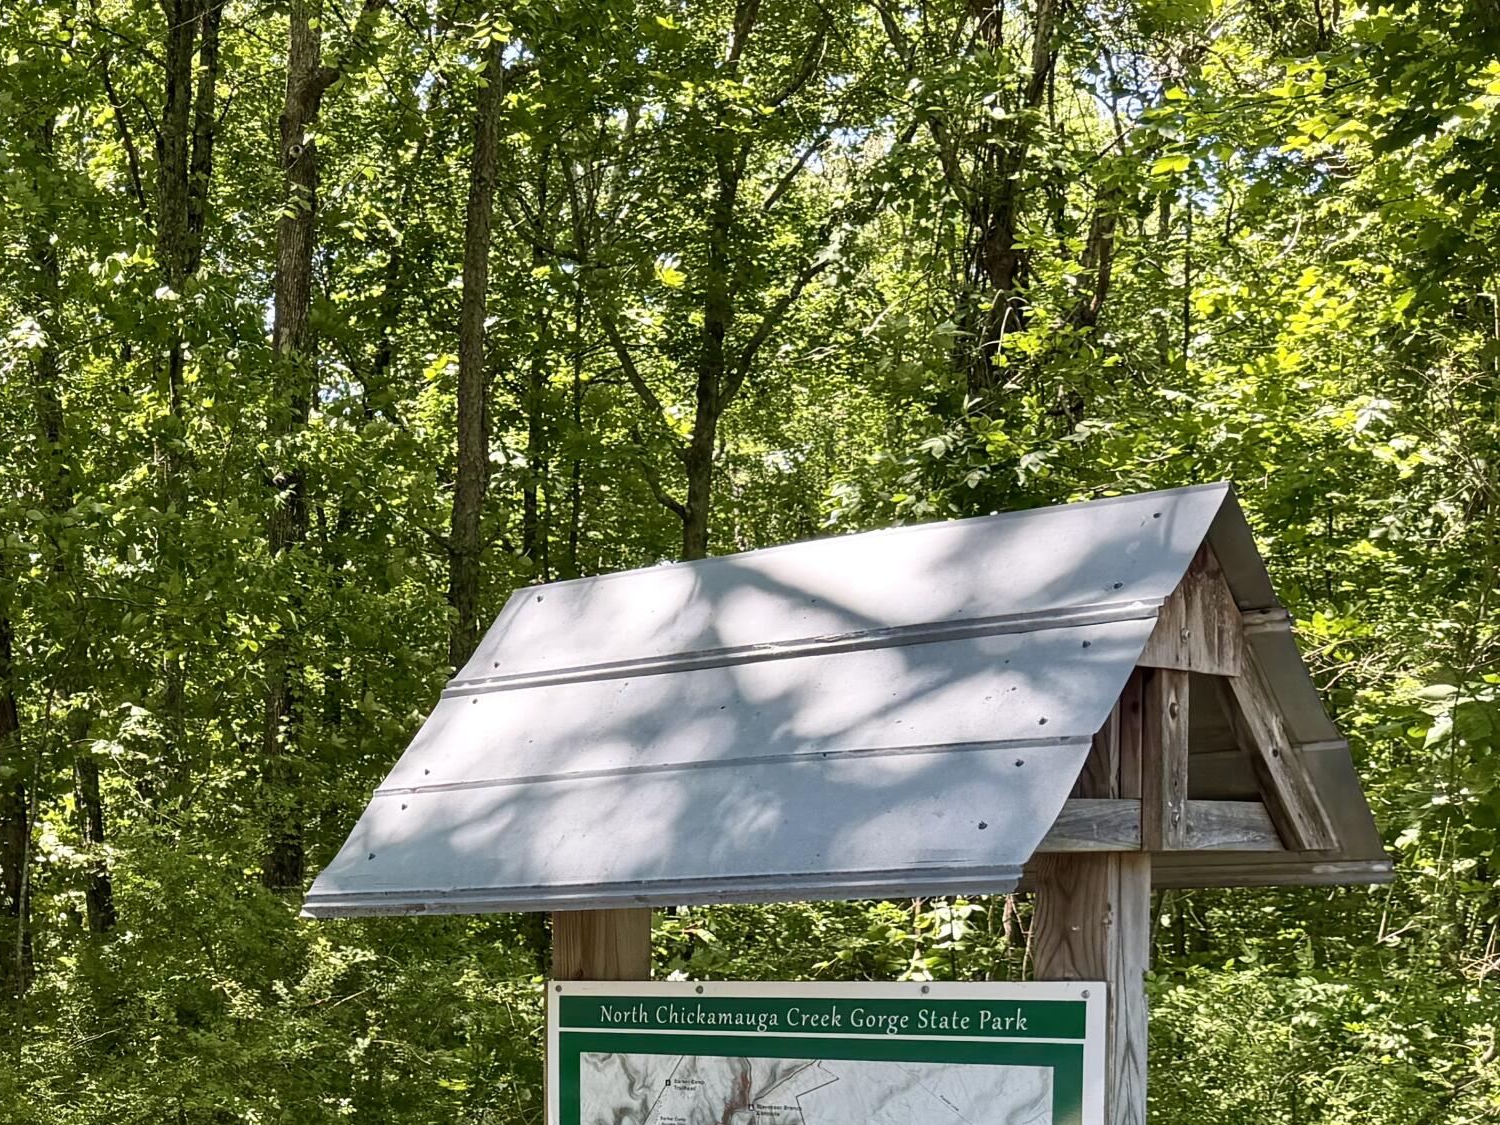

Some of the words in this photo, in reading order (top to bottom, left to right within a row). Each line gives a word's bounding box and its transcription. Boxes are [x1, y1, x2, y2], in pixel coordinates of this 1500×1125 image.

[600, 1003, 649, 1024] North
[656, 1003, 780, 1032] Chickamauga
[787, 1006, 842, 1027] Creek
[850, 1008, 909, 1035] Gorge
[917, 1009, 970, 1029] State
[979, 1008, 1028, 1031] Park
